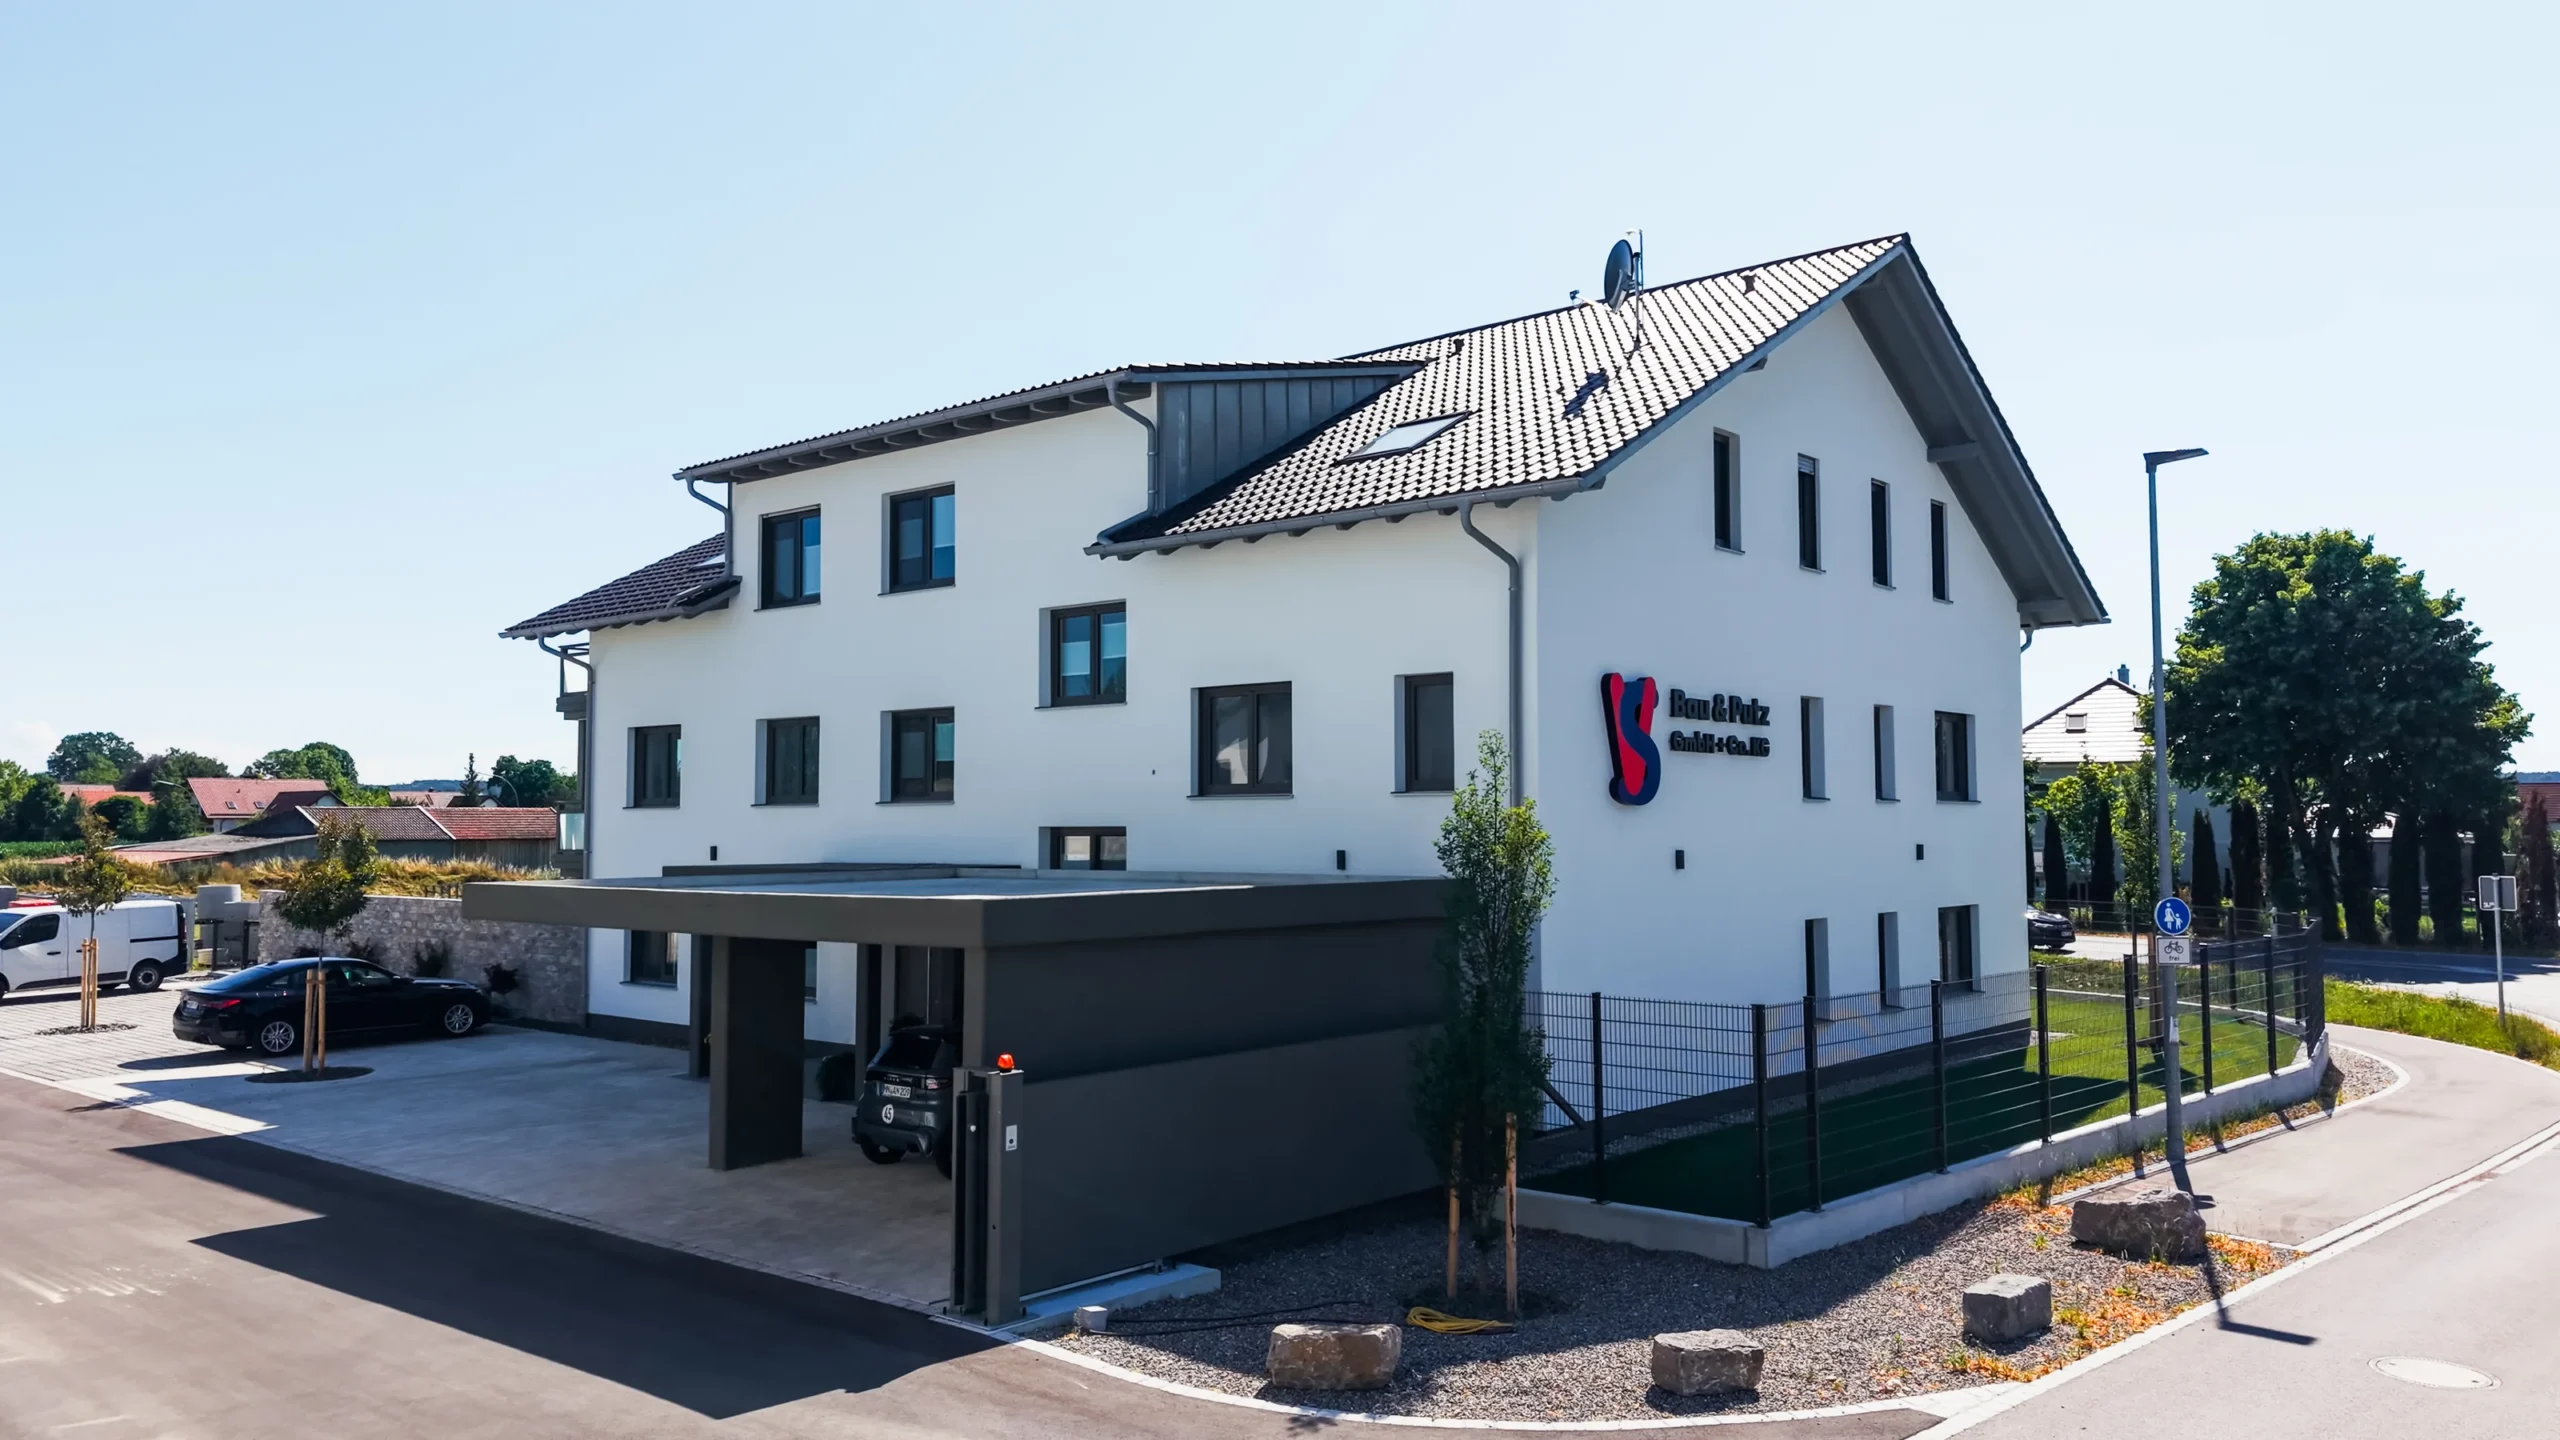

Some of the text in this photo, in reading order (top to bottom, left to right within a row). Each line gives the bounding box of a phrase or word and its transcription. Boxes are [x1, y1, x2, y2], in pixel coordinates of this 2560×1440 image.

[1669, 689, 1770, 726] Bau & Putz
[884, 1107, 892, 1120] 45
